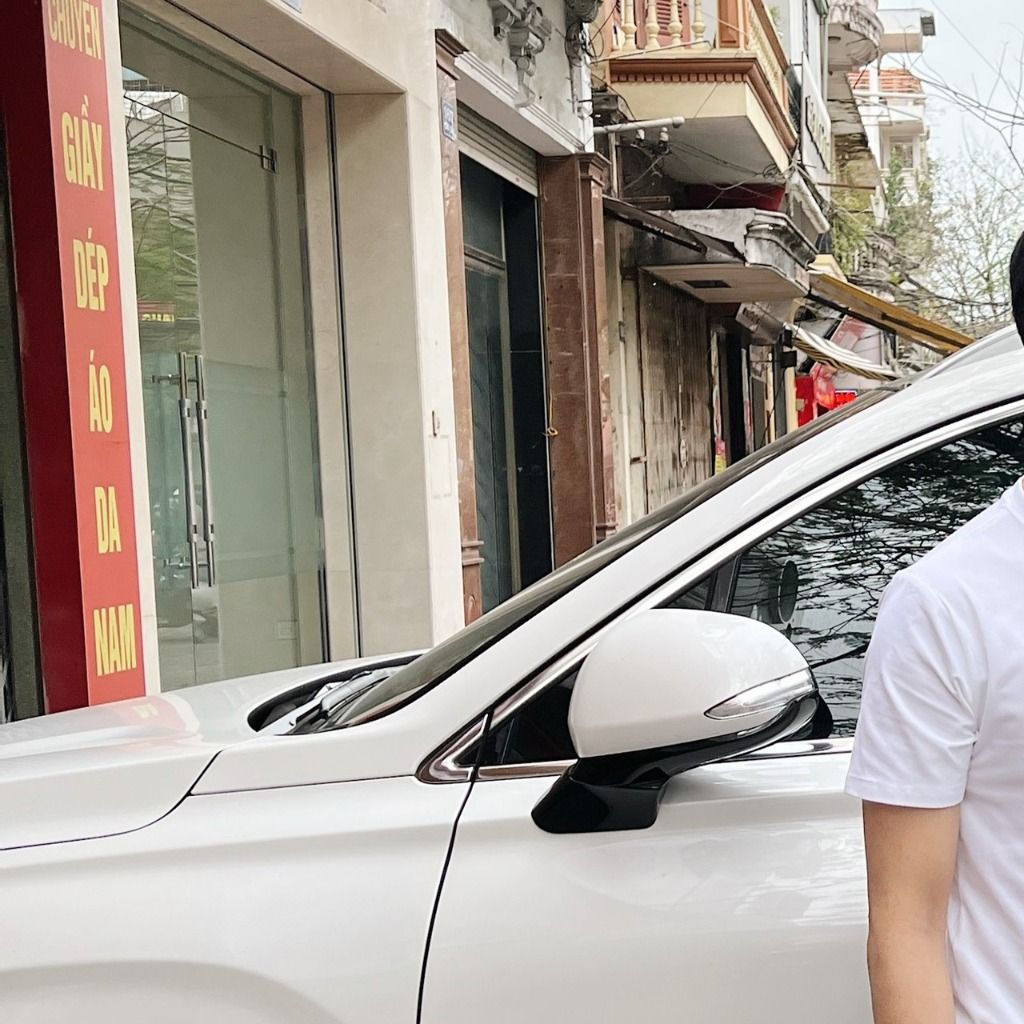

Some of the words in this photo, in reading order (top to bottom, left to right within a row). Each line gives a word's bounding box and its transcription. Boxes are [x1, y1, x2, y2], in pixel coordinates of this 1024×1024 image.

[73, 227, 108, 311] DÉP
[89, 350, 113, 433] ÁO
[95, 486, 121, 554] DA
[93, 603, 137, 676] NAM
